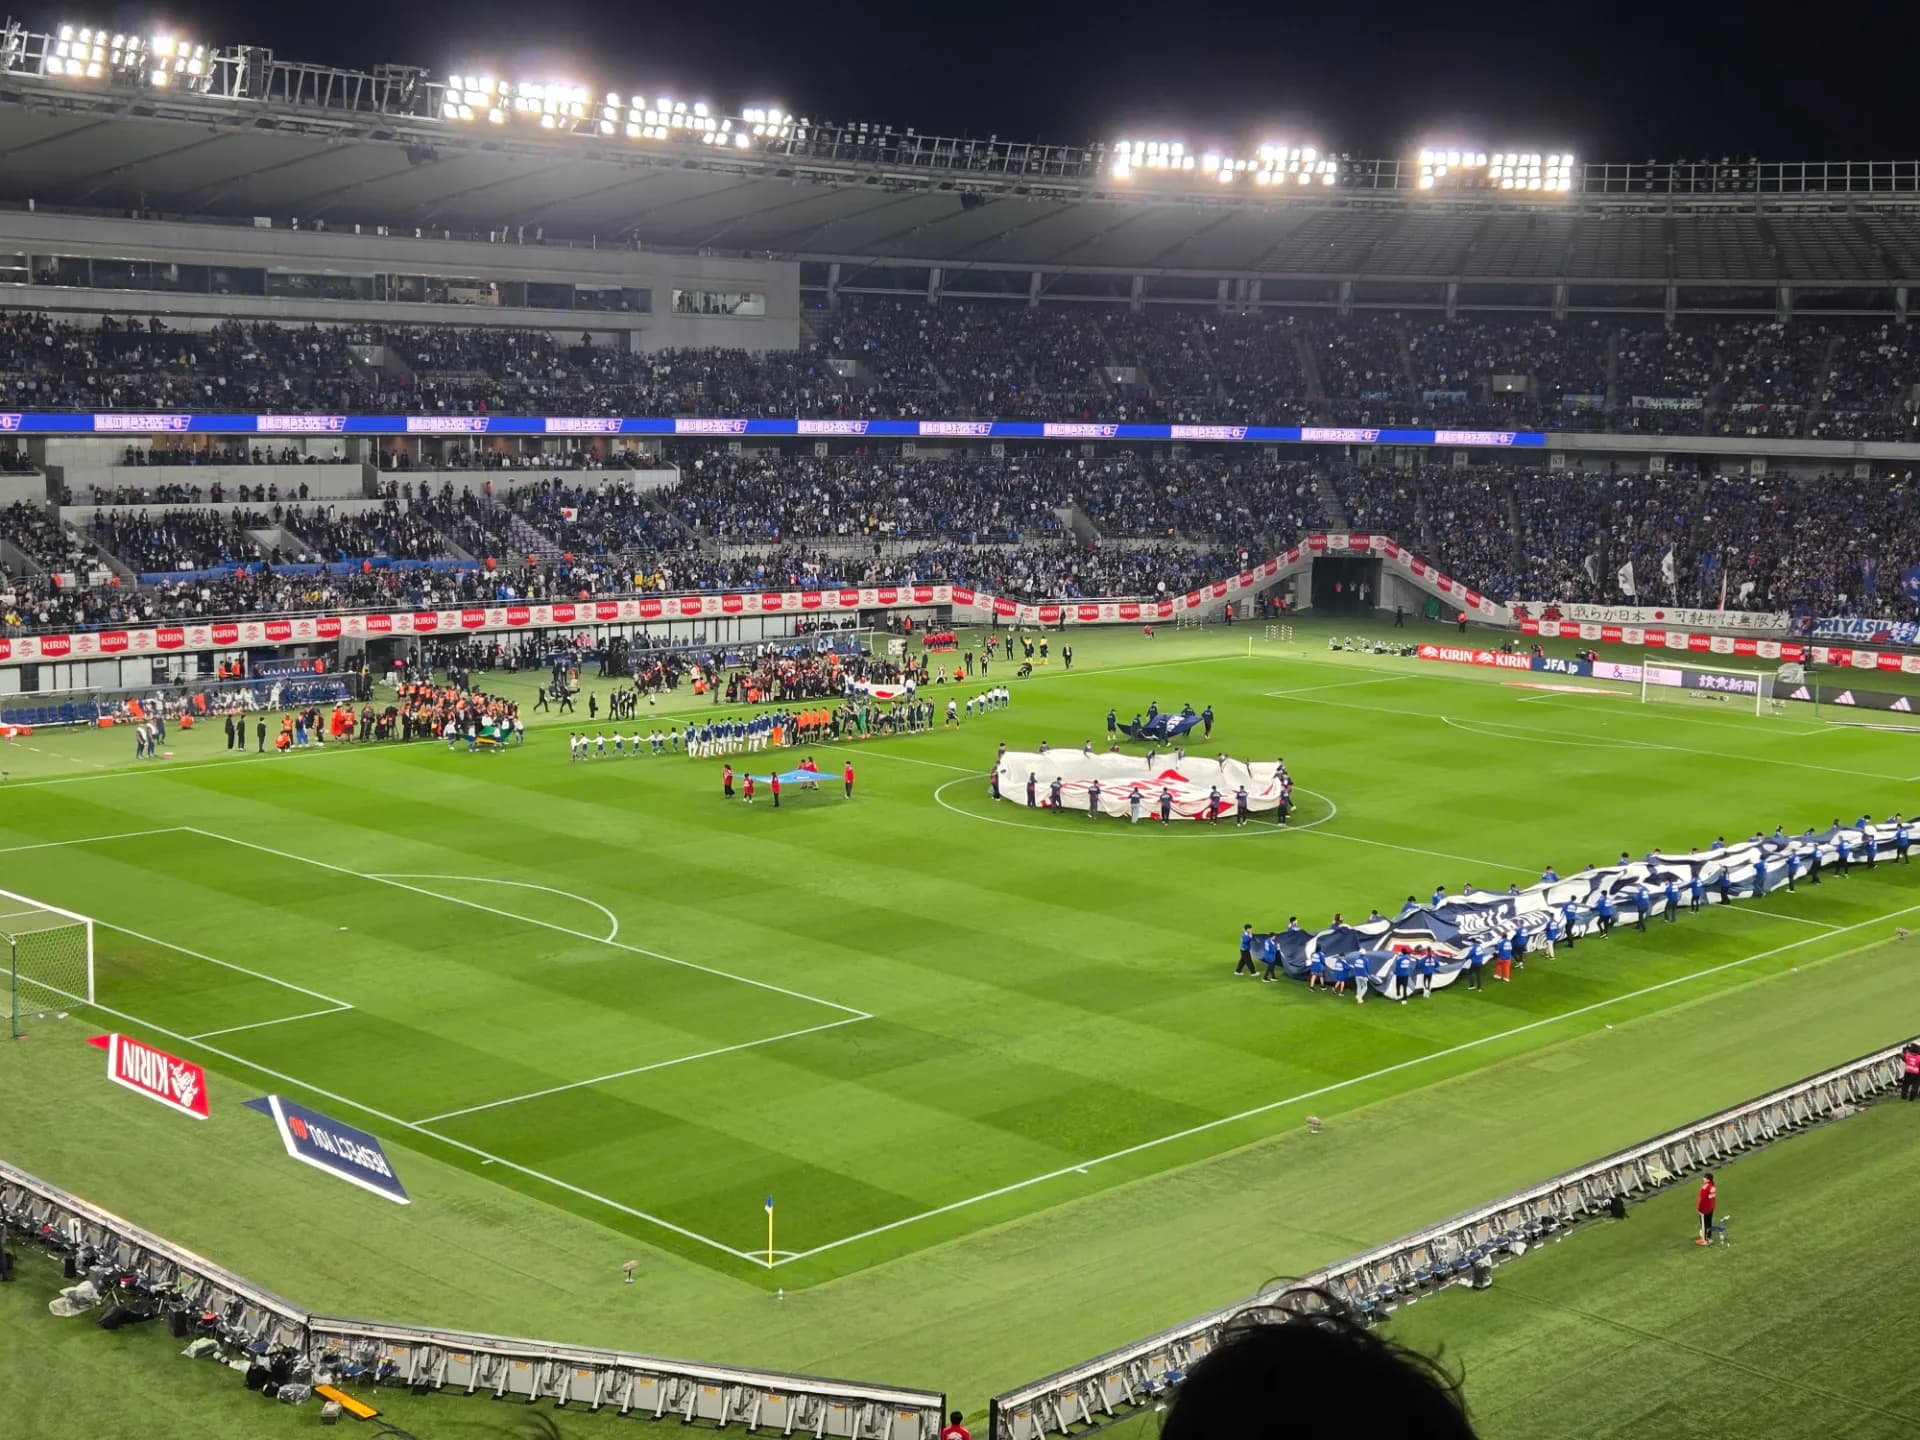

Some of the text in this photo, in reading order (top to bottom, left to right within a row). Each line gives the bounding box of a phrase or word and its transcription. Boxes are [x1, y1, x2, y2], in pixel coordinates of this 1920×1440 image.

[953, 590, 973, 600] KIRIN
[641, 604, 660, 612] KIRIN
[995, 602, 1015, 612] KIRIN
[508, 611, 528, 619] KIRIN
[554, 608, 574, 616] KIRIN
[1040, 608, 1058, 616] KIRIN
[463, 613, 484, 622] KIRIN
[317, 623, 340, 632] KIRIN
[368, 620, 390, 628] KIRIN
[213, 629, 237, 638] KIRIN
[266, 625, 290, 634] KIRIN
[1602, 630, 1621, 638] KIRIN
[101, 636, 127, 646] KIRIN
[158, 633, 183, 642] KIRIN
[1645, 634, 1665, 642] KIRIN
[1689, 638, 1710, 646] KIRIN
[42, 640, 69, 650] KIRIN
[1735, 643, 1756, 651] KIRIN
[1440, 648, 1473, 662] KIRIN
[1496, 654, 1531, 669] KIRIN
[1878, 657, 1901, 666] KIRIN
[122, 1040, 169, 1096] KIRIN
[333, 1134, 392, 1178] RESPECT
